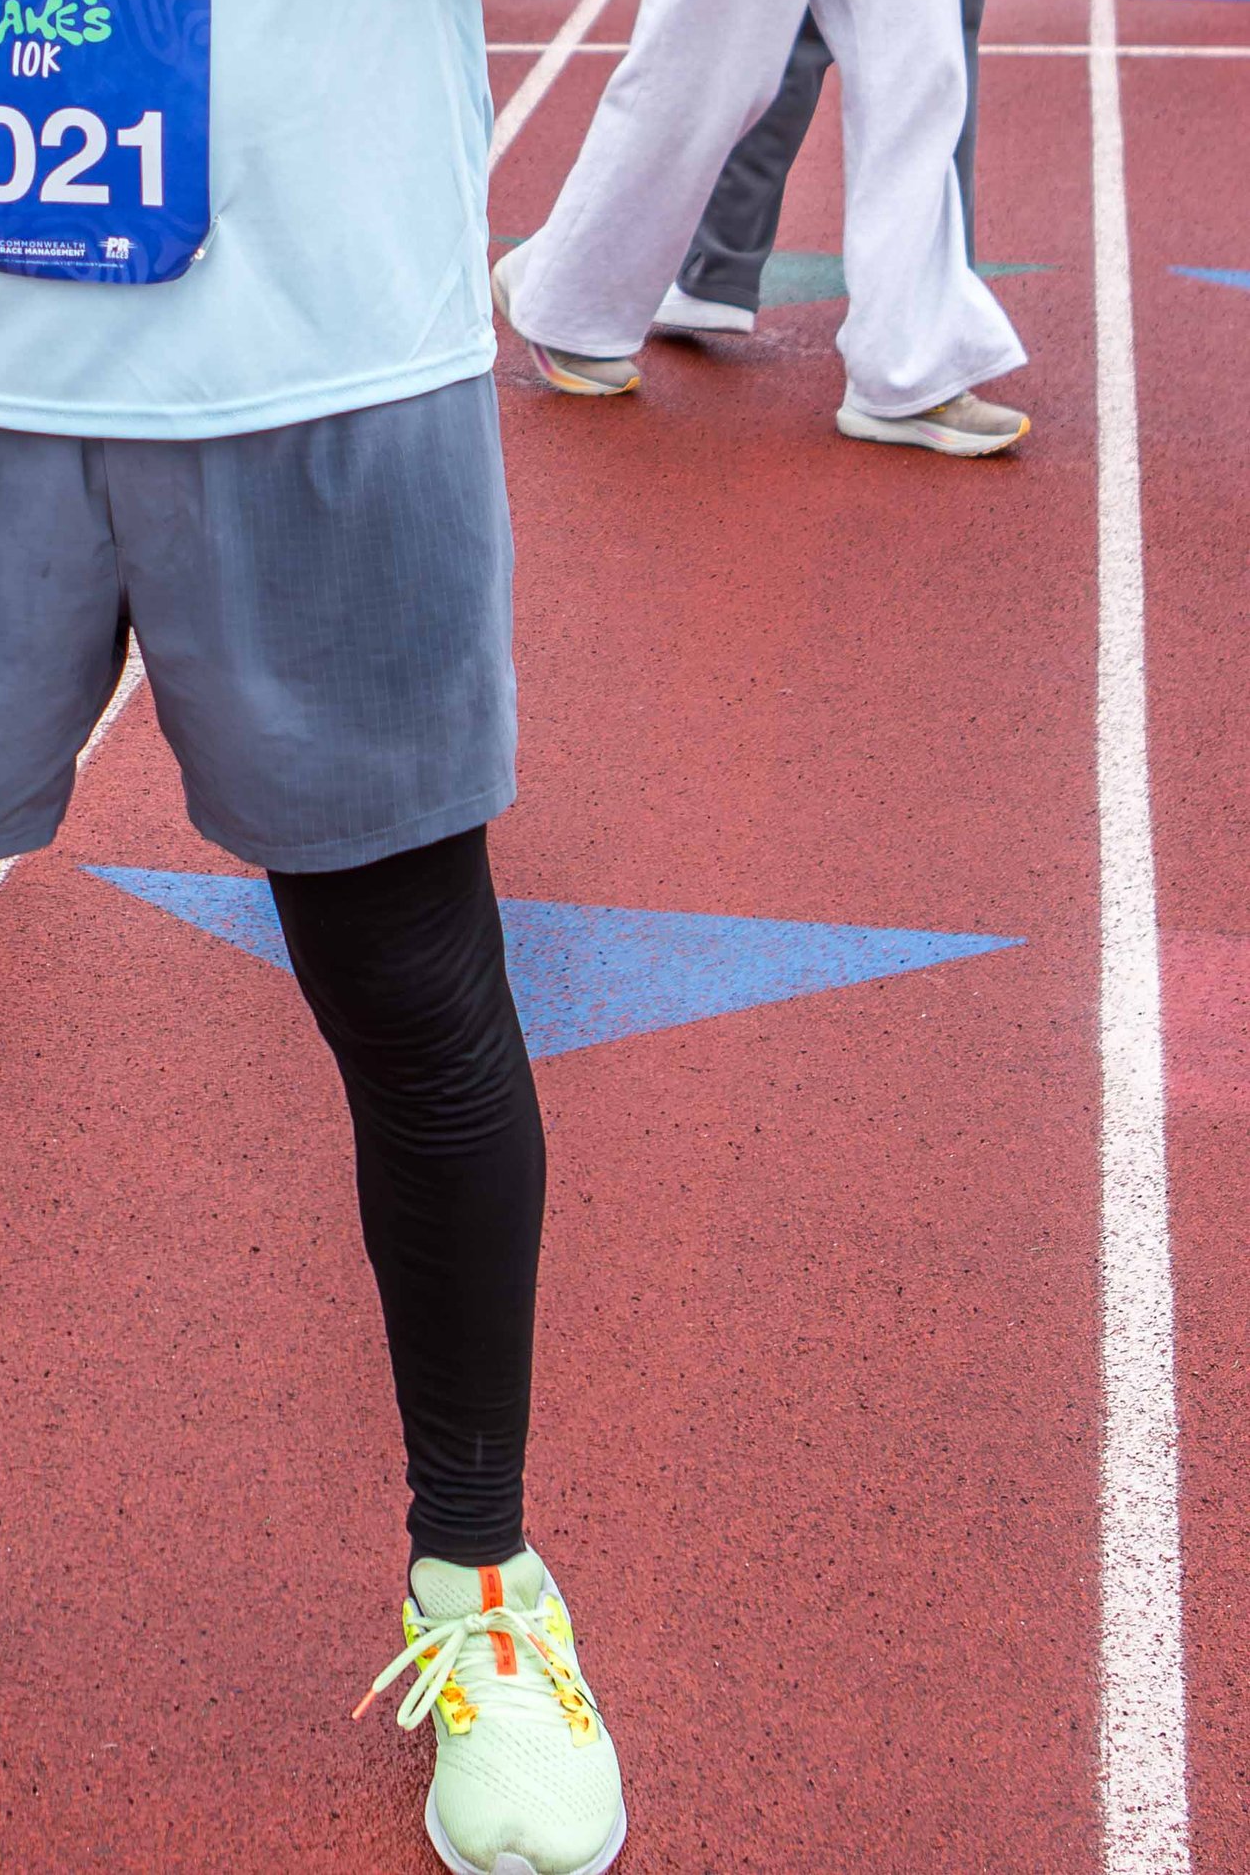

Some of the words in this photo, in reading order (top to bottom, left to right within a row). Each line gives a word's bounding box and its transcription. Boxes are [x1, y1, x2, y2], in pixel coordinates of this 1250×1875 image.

[11, 41, 61, 78] 10K
[0, 240, 86, 250] COMMONWEALTH
[107, 237, 130, 252] PR
[0, 247, 23, 255] RACE
[25, 247, 87, 257] MANAGEMENT
